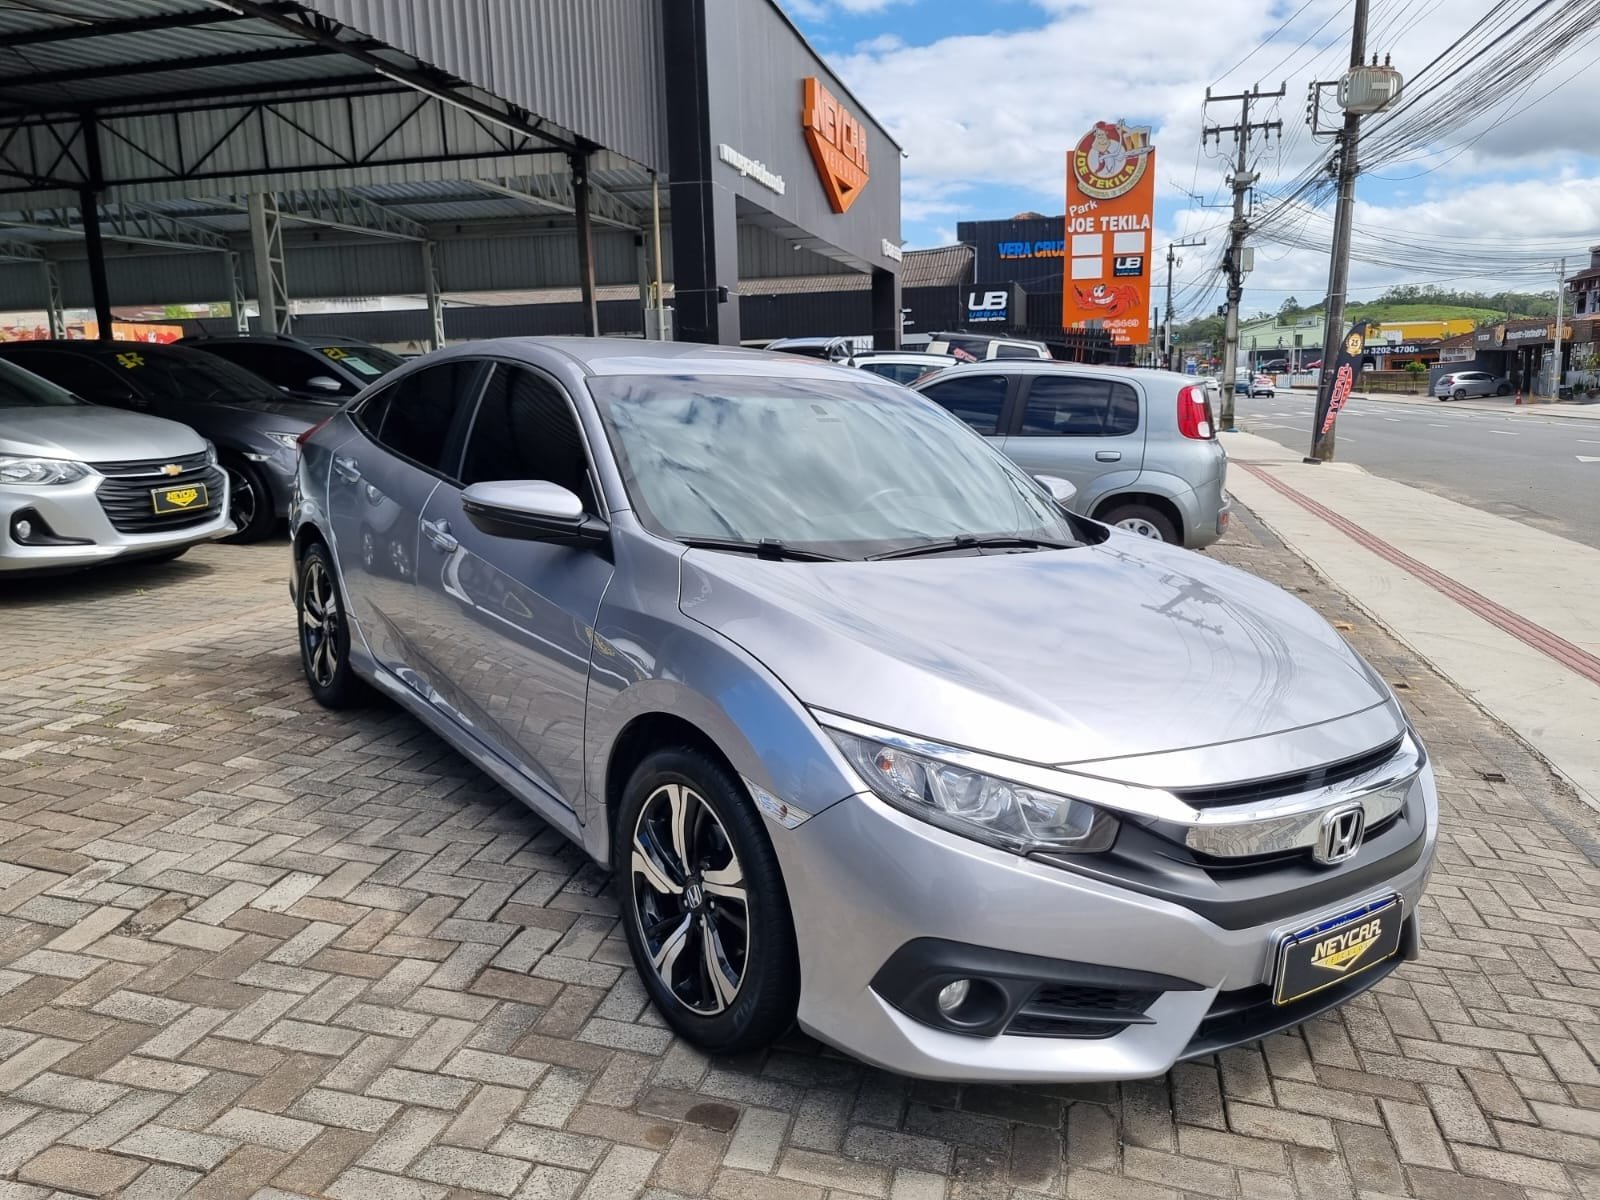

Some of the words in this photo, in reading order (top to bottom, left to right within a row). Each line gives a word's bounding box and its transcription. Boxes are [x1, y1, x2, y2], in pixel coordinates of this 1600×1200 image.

[808, 77, 868, 175] NEYCAR
[1077, 150, 1089, 176] JOE
[1088, 164, 1135, 189] TEKILA
[1069, 200, 1098, 217] Park
[1067, 216, 1094, 232] JOE
[1100, 214, 1150, 231] TEKILA
[998, 242, 1031, 258] VERA
[1116, 257, 1141, 269] UB
[968, 291, 1008, 310] UB
[1371, 346, 1414, 354] 3202-4700
[1322, 364, 1353, 434] NEYCAR
[1311, 918, 1382, 962] NEYCAR
